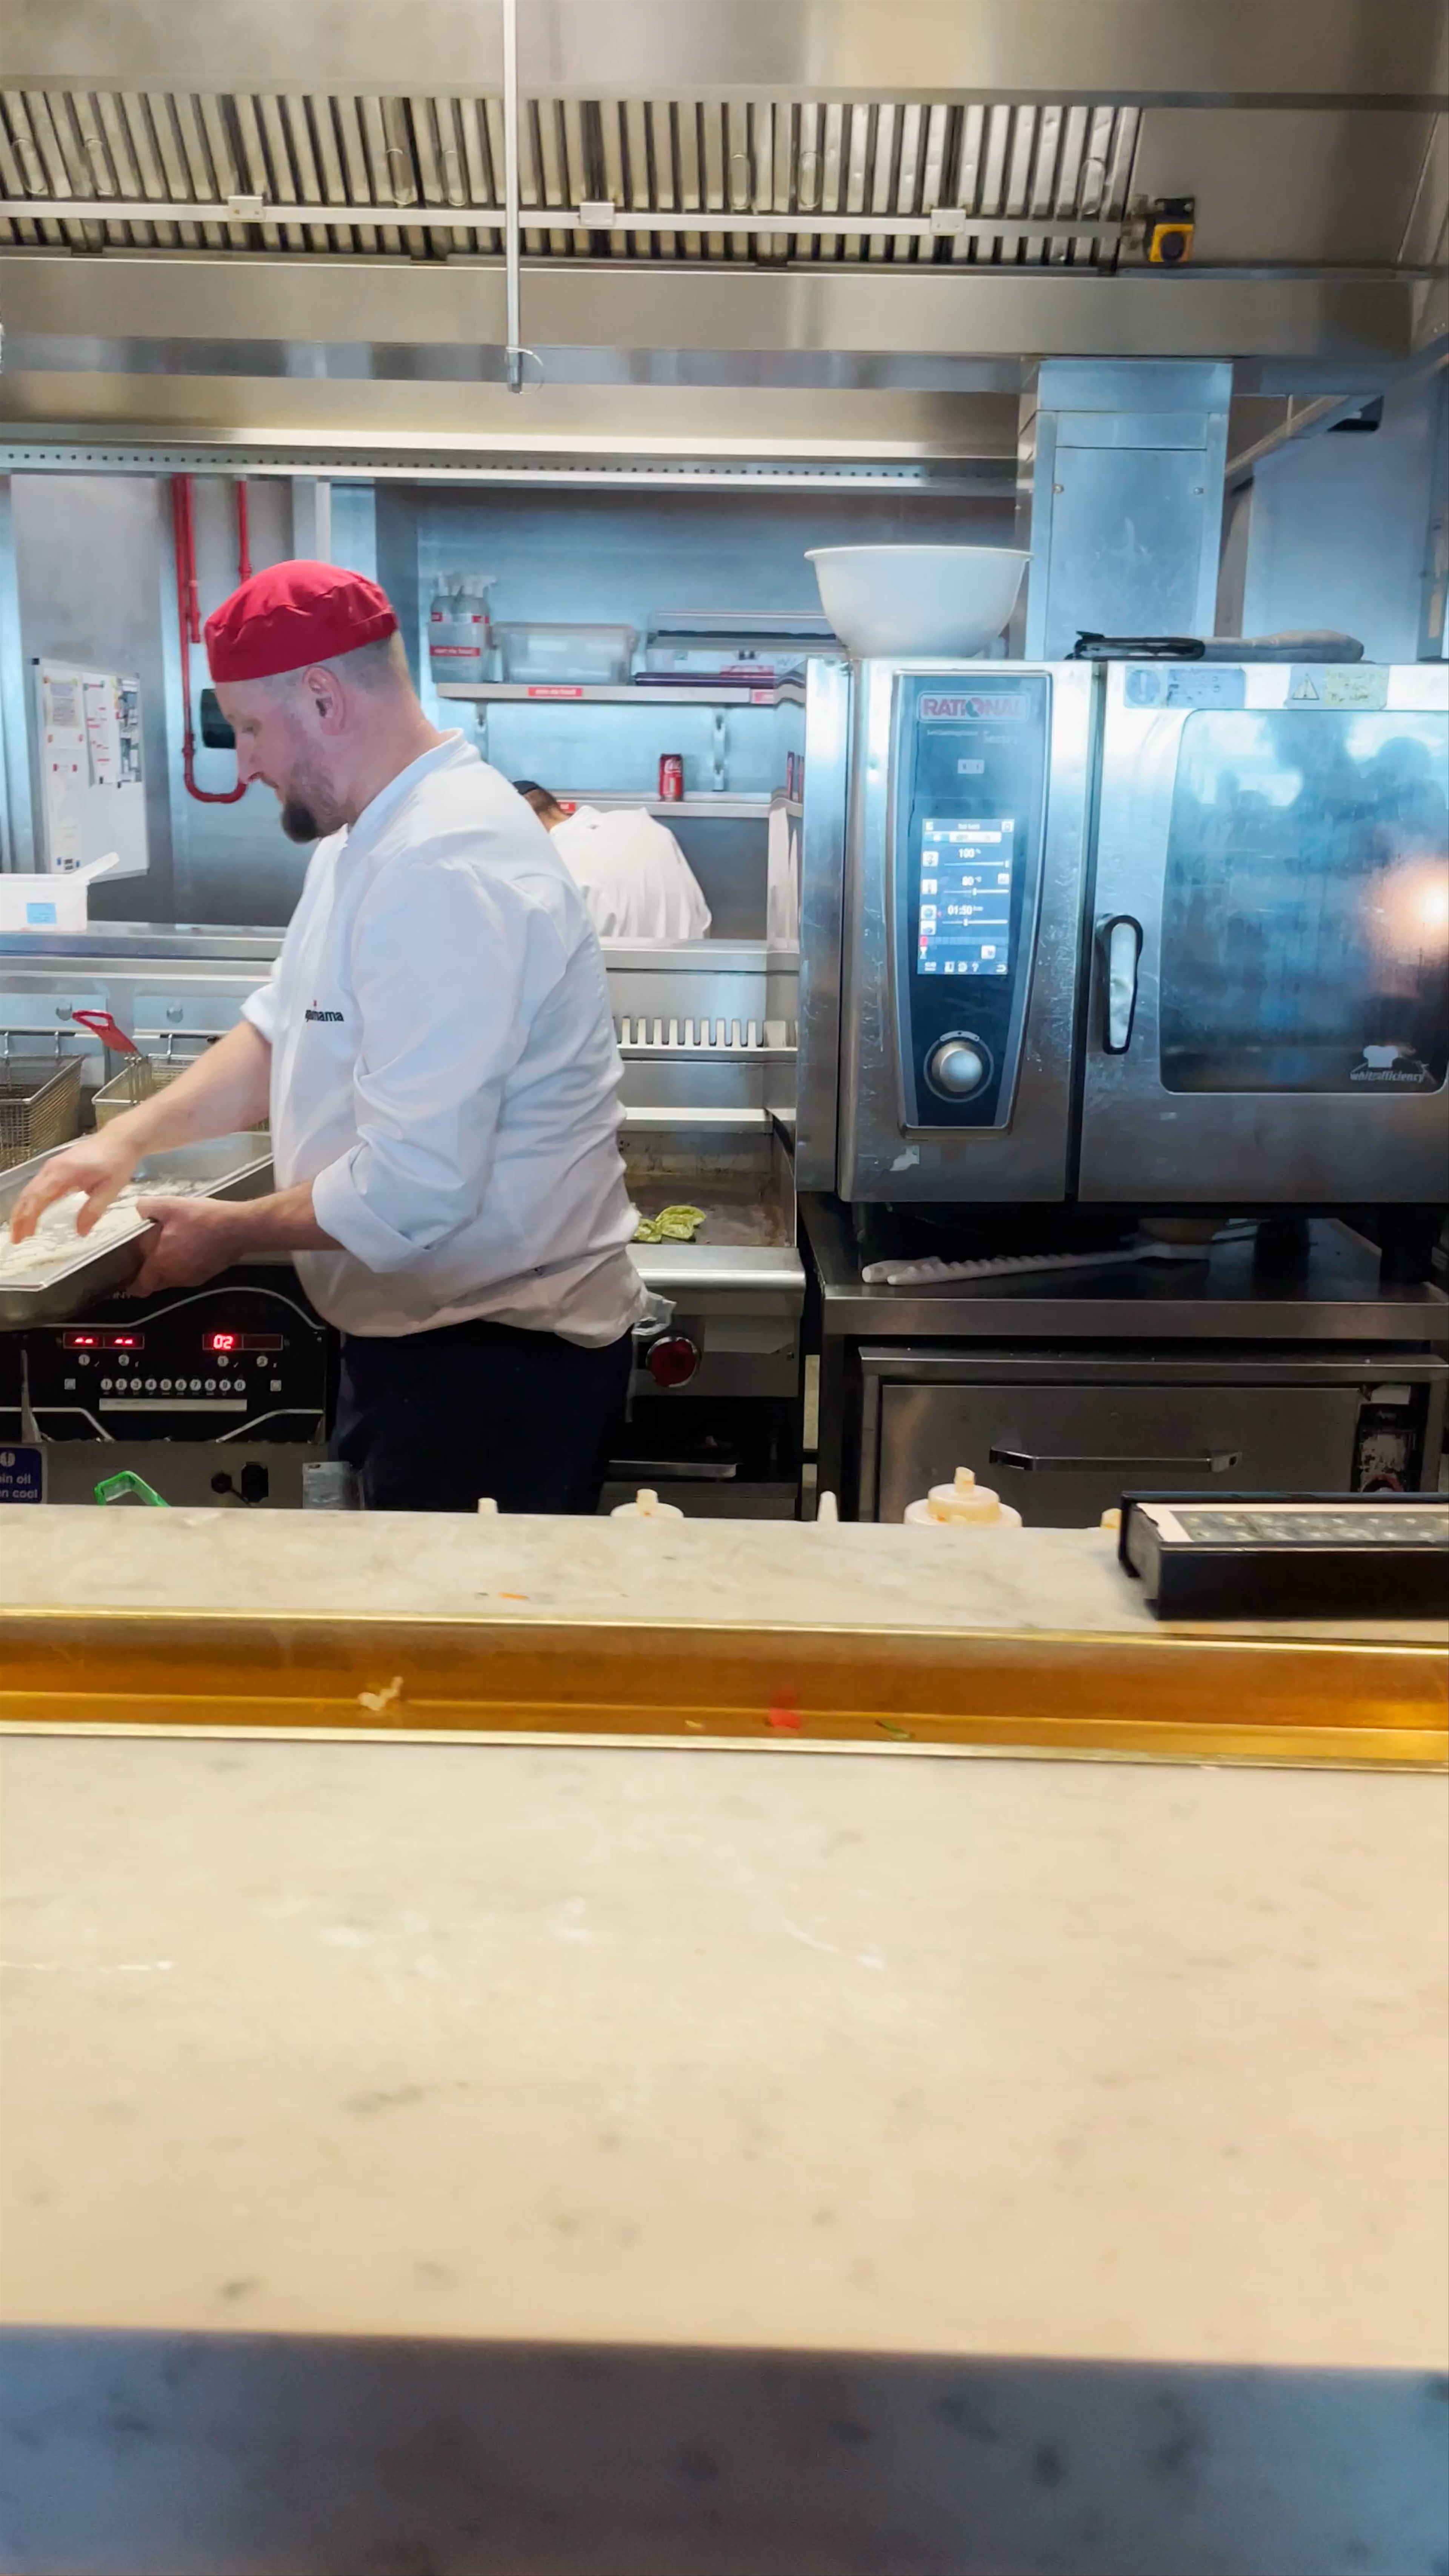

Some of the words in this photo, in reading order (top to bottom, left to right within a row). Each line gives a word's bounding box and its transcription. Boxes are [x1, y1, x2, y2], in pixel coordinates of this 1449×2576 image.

[923, 697, 1021, 717] RATIONAL
[213, 1334, 233, 1349] 02
[16, 1473, 31, 1484] oil
[0, 1489, 9, 1498] n
